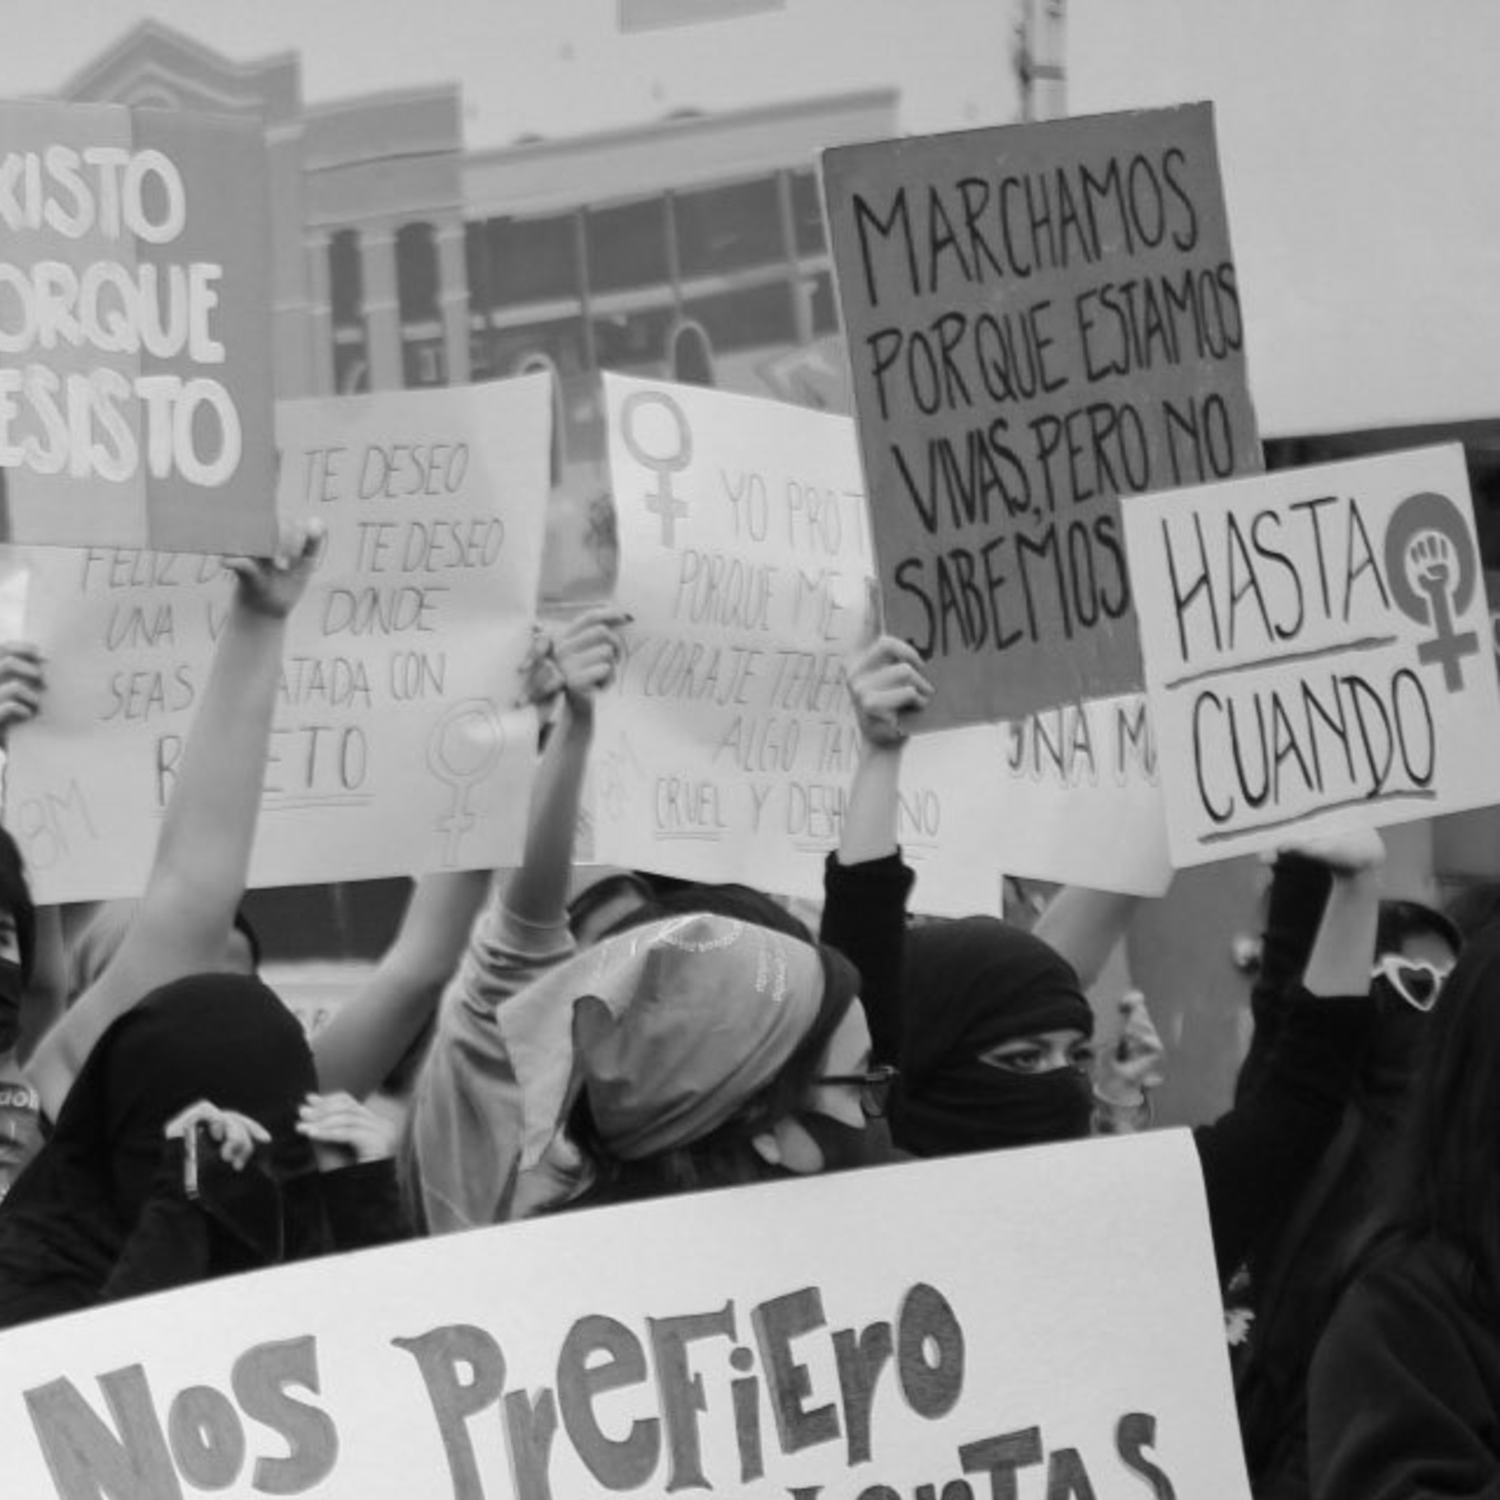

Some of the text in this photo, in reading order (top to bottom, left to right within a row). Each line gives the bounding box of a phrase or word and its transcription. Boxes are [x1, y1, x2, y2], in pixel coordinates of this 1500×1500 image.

[852, 147, 1198, 306] MARCHAMOS
[867, 261, 1244, 420] PORQUE ESTAMOS
[302, 442, 470, 503] TE DESEO
[1162, 392, 1235, 485] NO
[356, 521, 400, 574] TE
[400, 517, 504, 574] DESEO
[895, 514, 1131, 660] SABEMOS
[1162, 496, 1391, 663] HASTA
[321, 586, 451, 637] DONDE
[97, 664, 197, 720] SEAS
[1192, 667, 1435, 823] CUANDO
